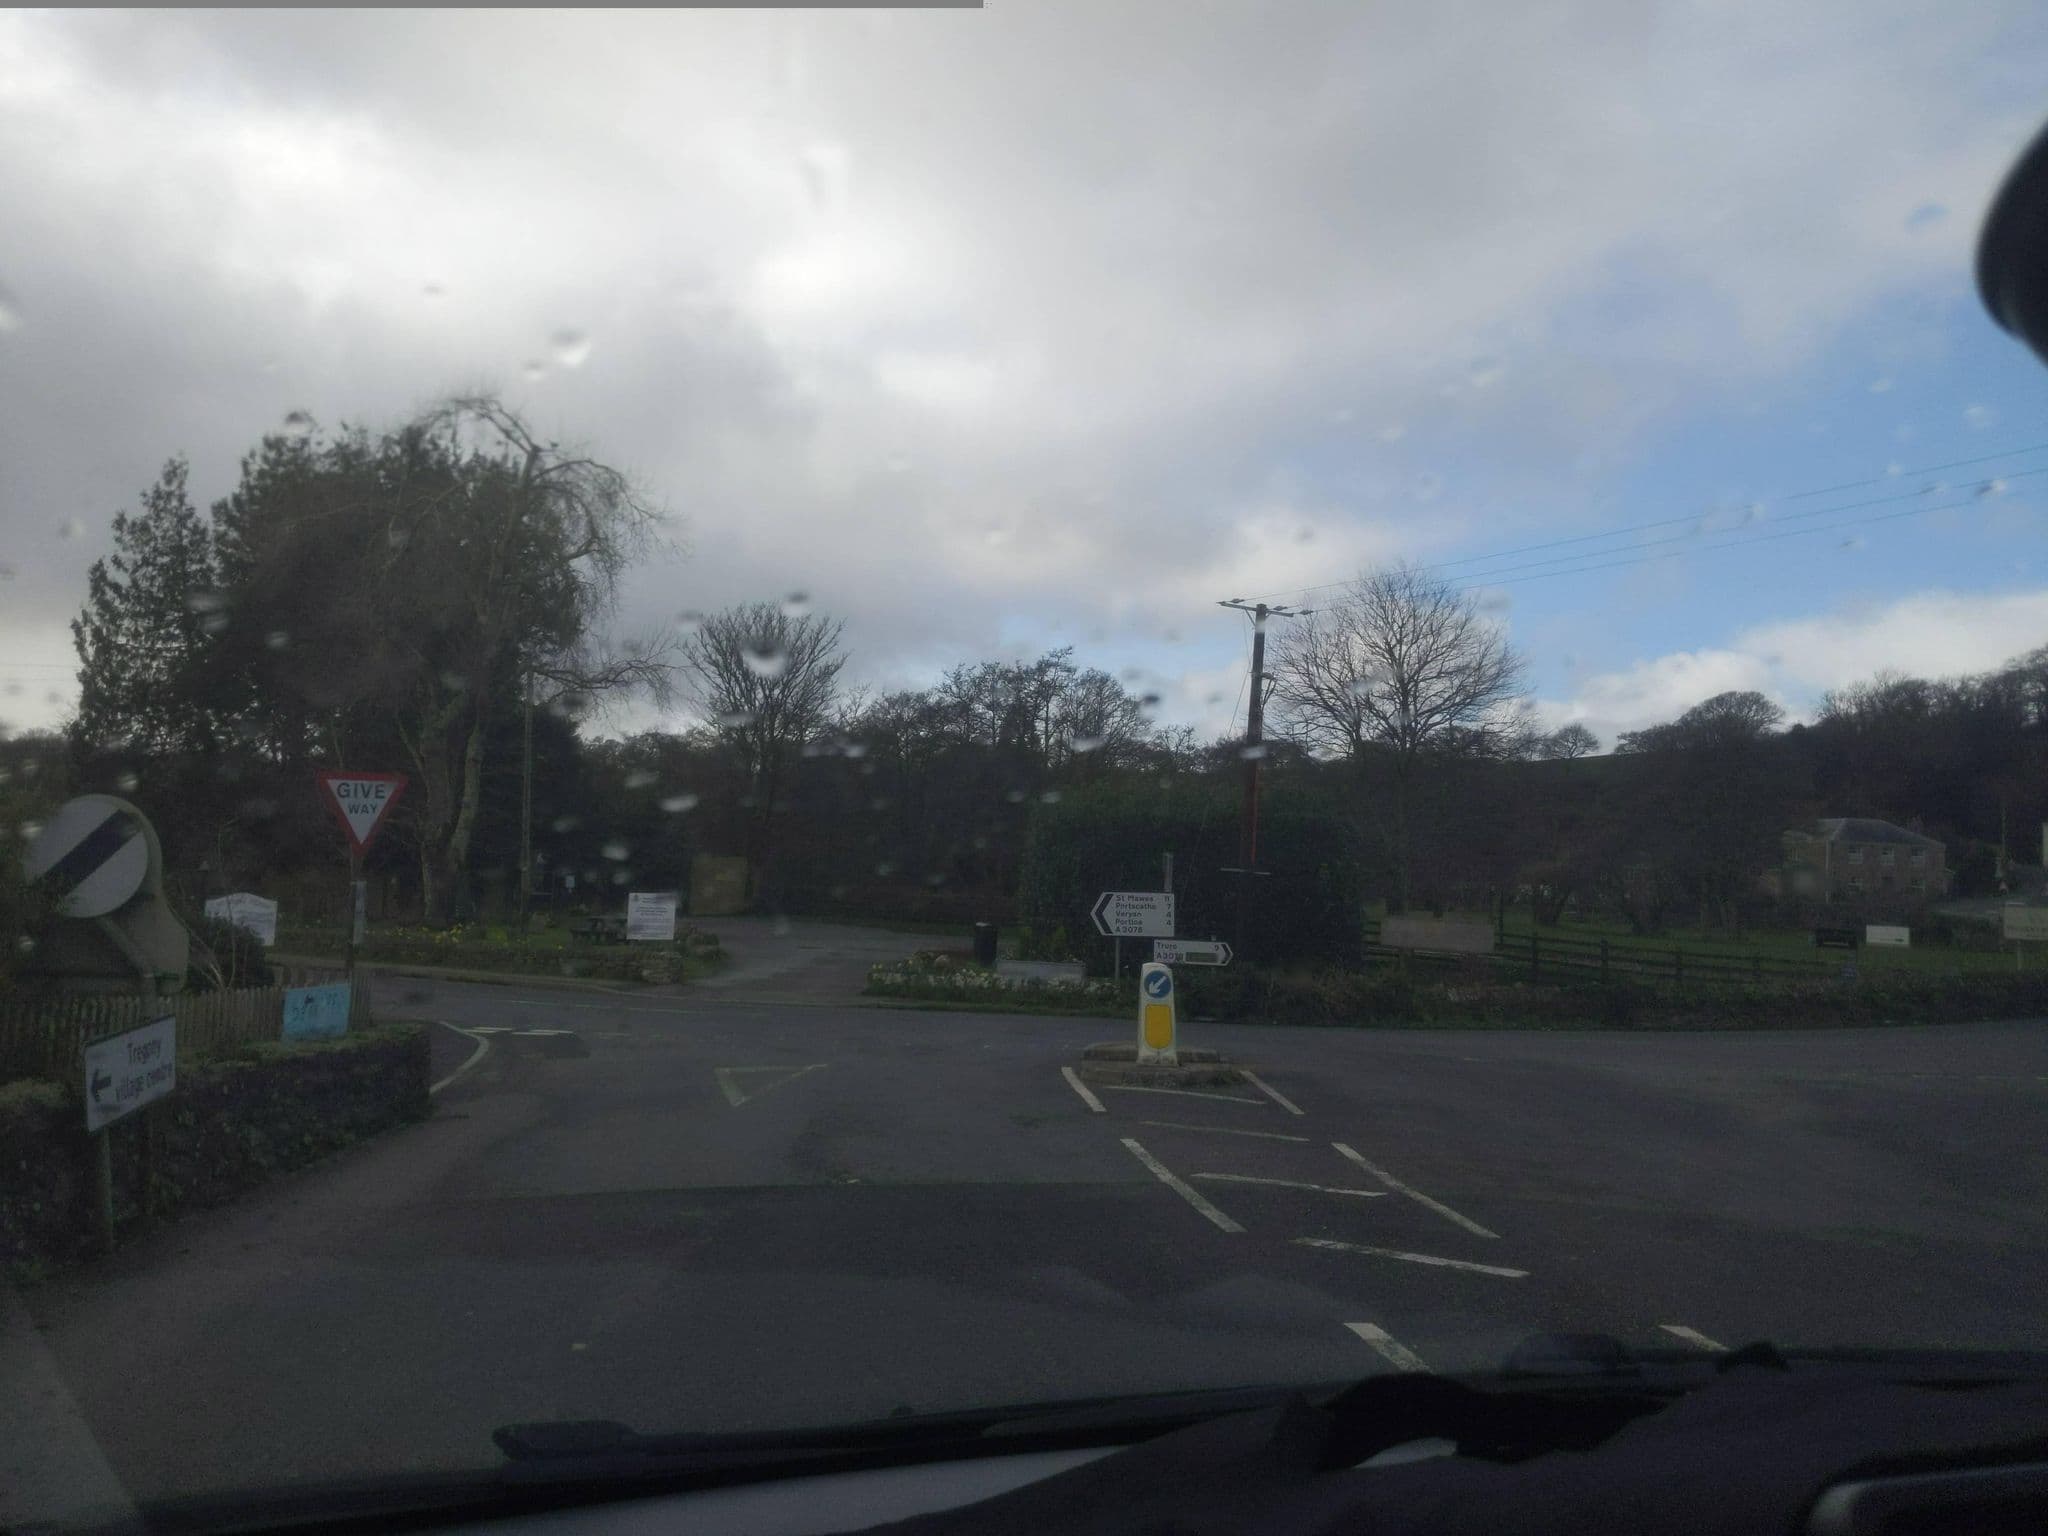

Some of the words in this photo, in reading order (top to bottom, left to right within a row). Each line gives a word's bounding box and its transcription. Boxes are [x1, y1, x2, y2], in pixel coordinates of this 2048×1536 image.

[337, 782, 386, 799] GIVE
[347, 803, 378, 815] WAY
[1115, 894, 1125, 902] St
[1128, 894, 1154, 902] Mawes
[1115, 902, 1157, 910] Portscatho
[1156, 941, 1178, 949] Truro
[127, 1040, 160, 1064] Tregony
